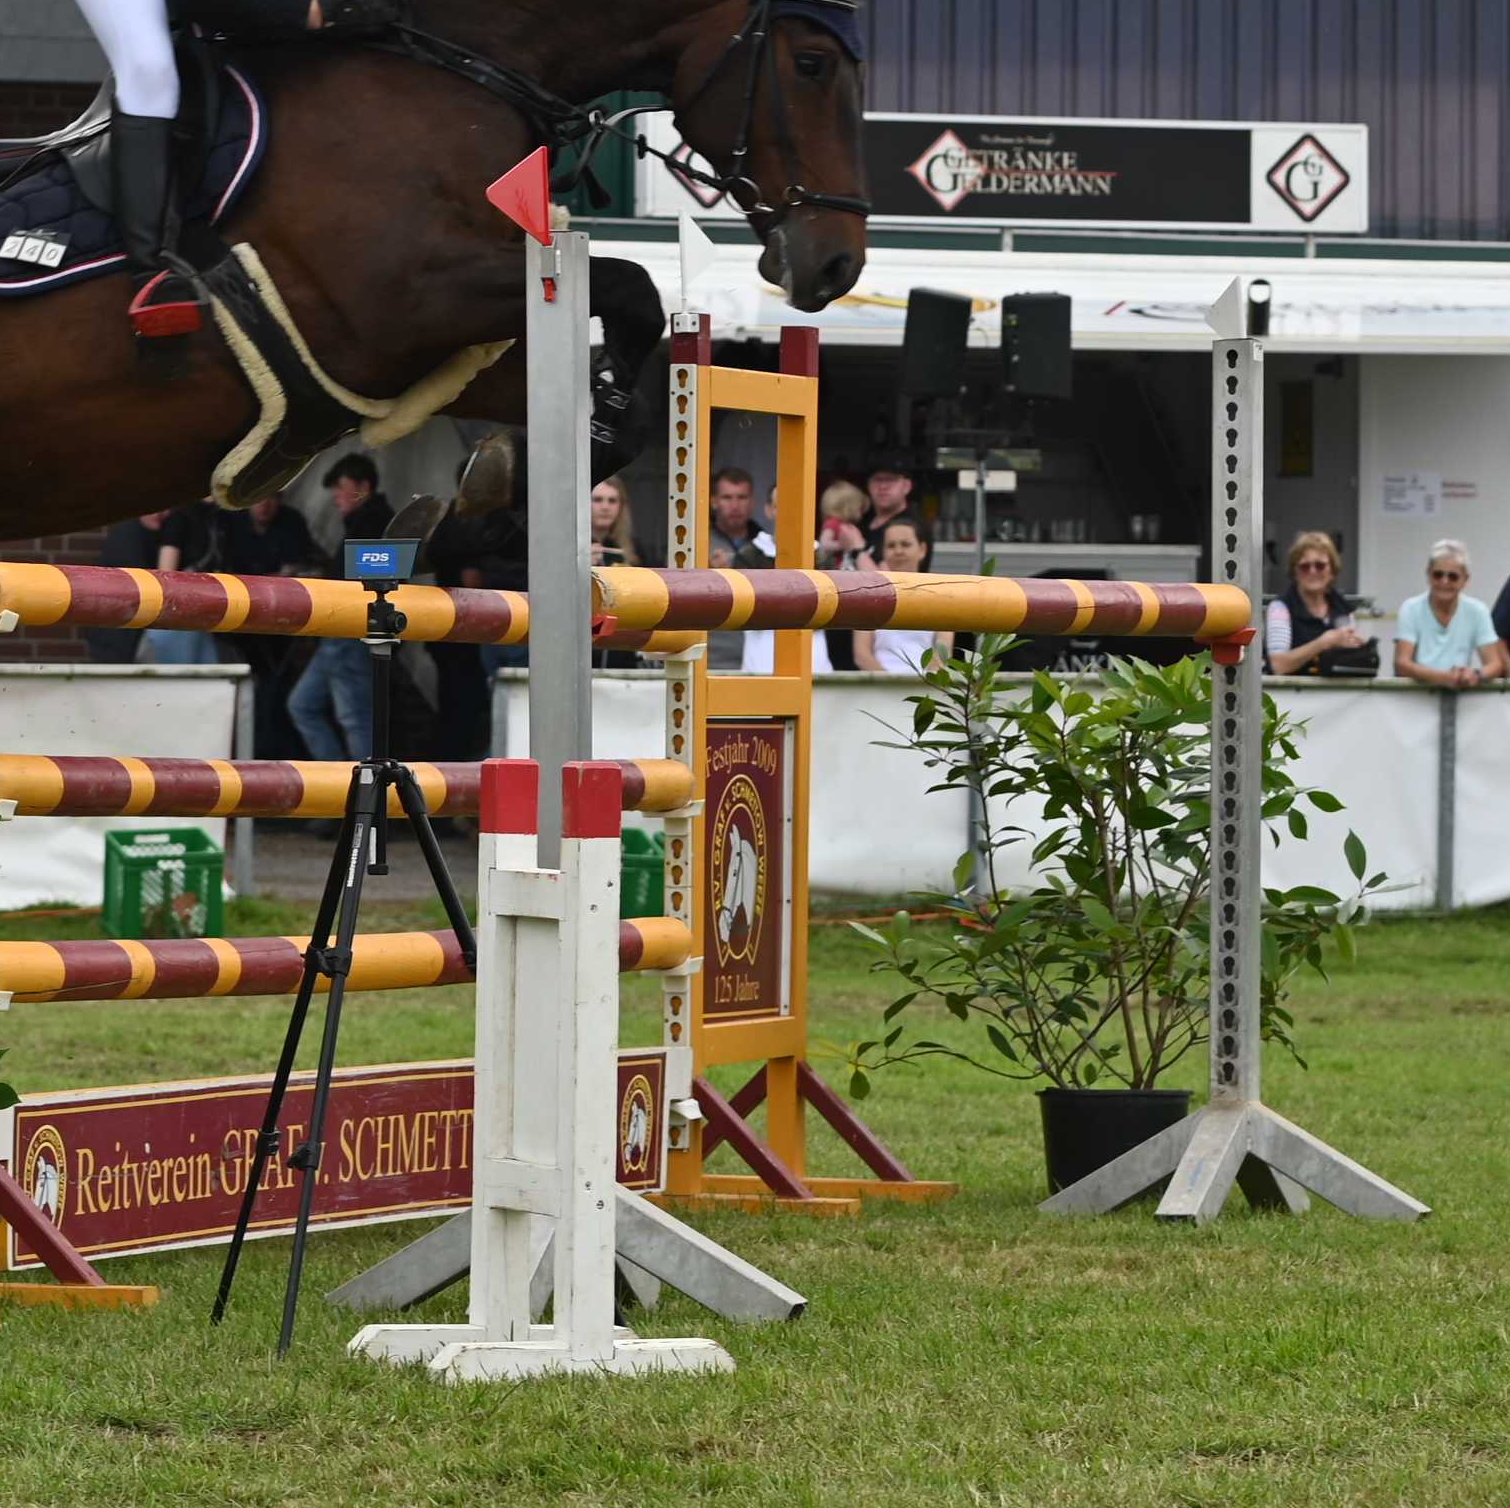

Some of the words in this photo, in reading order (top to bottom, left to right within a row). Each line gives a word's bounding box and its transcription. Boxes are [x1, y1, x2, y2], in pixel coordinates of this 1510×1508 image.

[926, 154, 1112, 195] GELDERMANN
[943, 146, 1078, 172] GETRÄNKE
[361, 552, 390, 562] FDS
[706, 733, 750, 778] Festjahr
[751, 735, 778, 776] 2009
[714, 975, 732, 1004] 125
[733, 973, 760, 1002] Jahre
[75, 1132, 212, 1216] Reitverein
